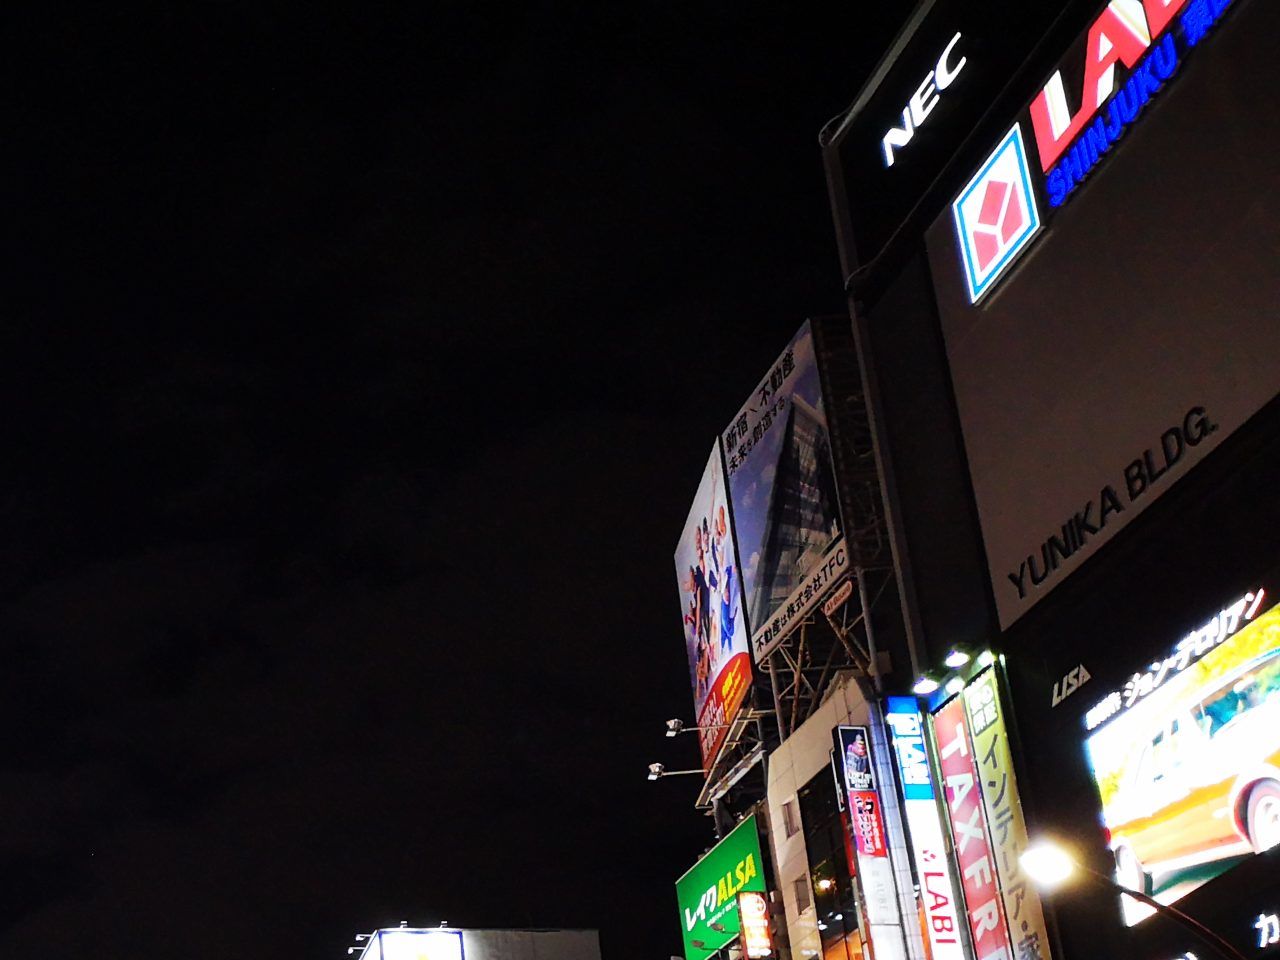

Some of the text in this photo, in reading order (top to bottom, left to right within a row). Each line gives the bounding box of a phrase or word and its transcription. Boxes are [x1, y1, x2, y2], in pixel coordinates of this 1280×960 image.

[881, 31, 966, 167] NEC
[1046, 32, 1178, 208] SHINJUKU
[1008, 404, 1220, 600] YUNIKA BLDG.
[1052, 663, 1092, 709] LISA
[923, 872, 957, 944] LABI
